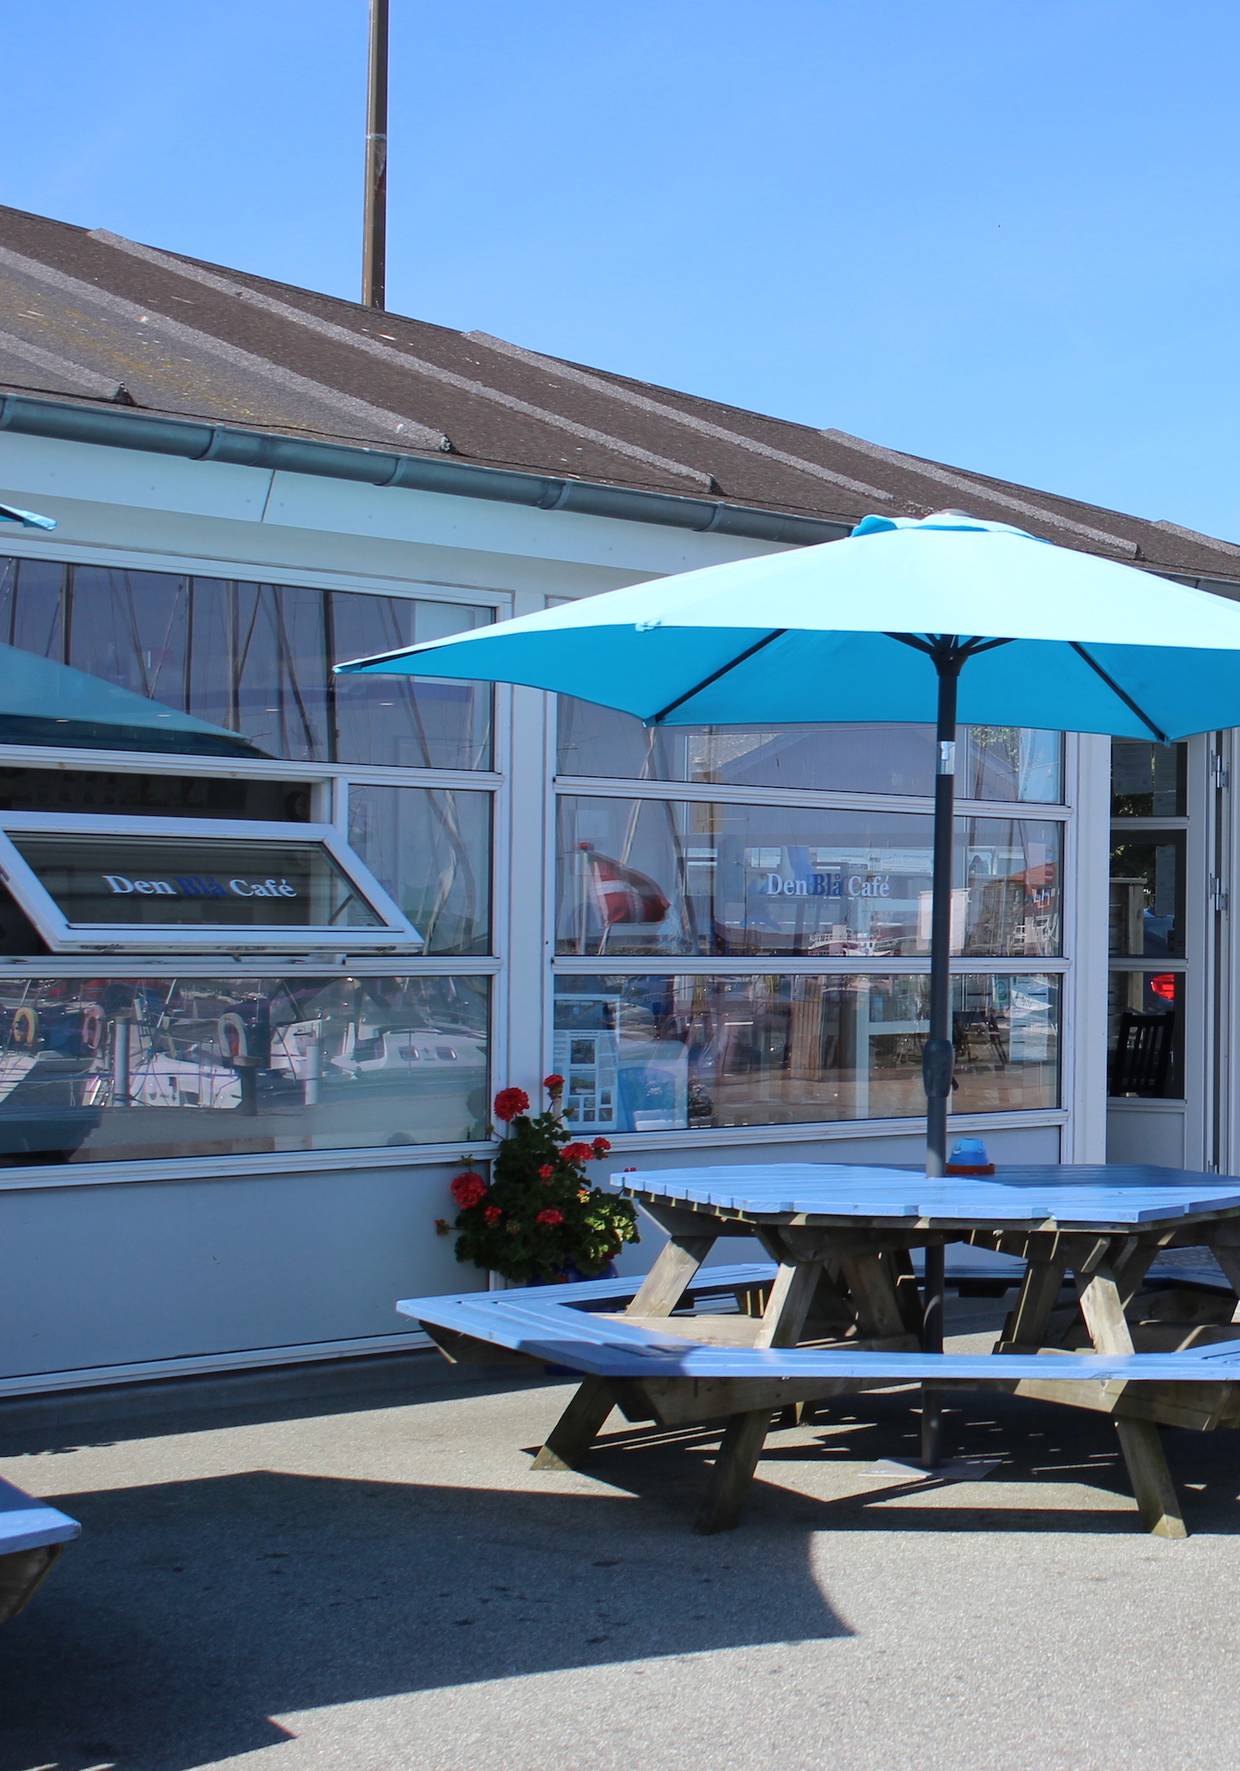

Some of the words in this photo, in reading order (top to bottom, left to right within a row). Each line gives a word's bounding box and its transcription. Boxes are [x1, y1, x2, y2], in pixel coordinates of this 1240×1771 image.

[102, 875, 177, 895] Den
[229, 878, 298, 898] Café
[766, 873, 809, 896] Den
[812, 872, 842, 896] Blå
[847, 874, 891, 898] Café
